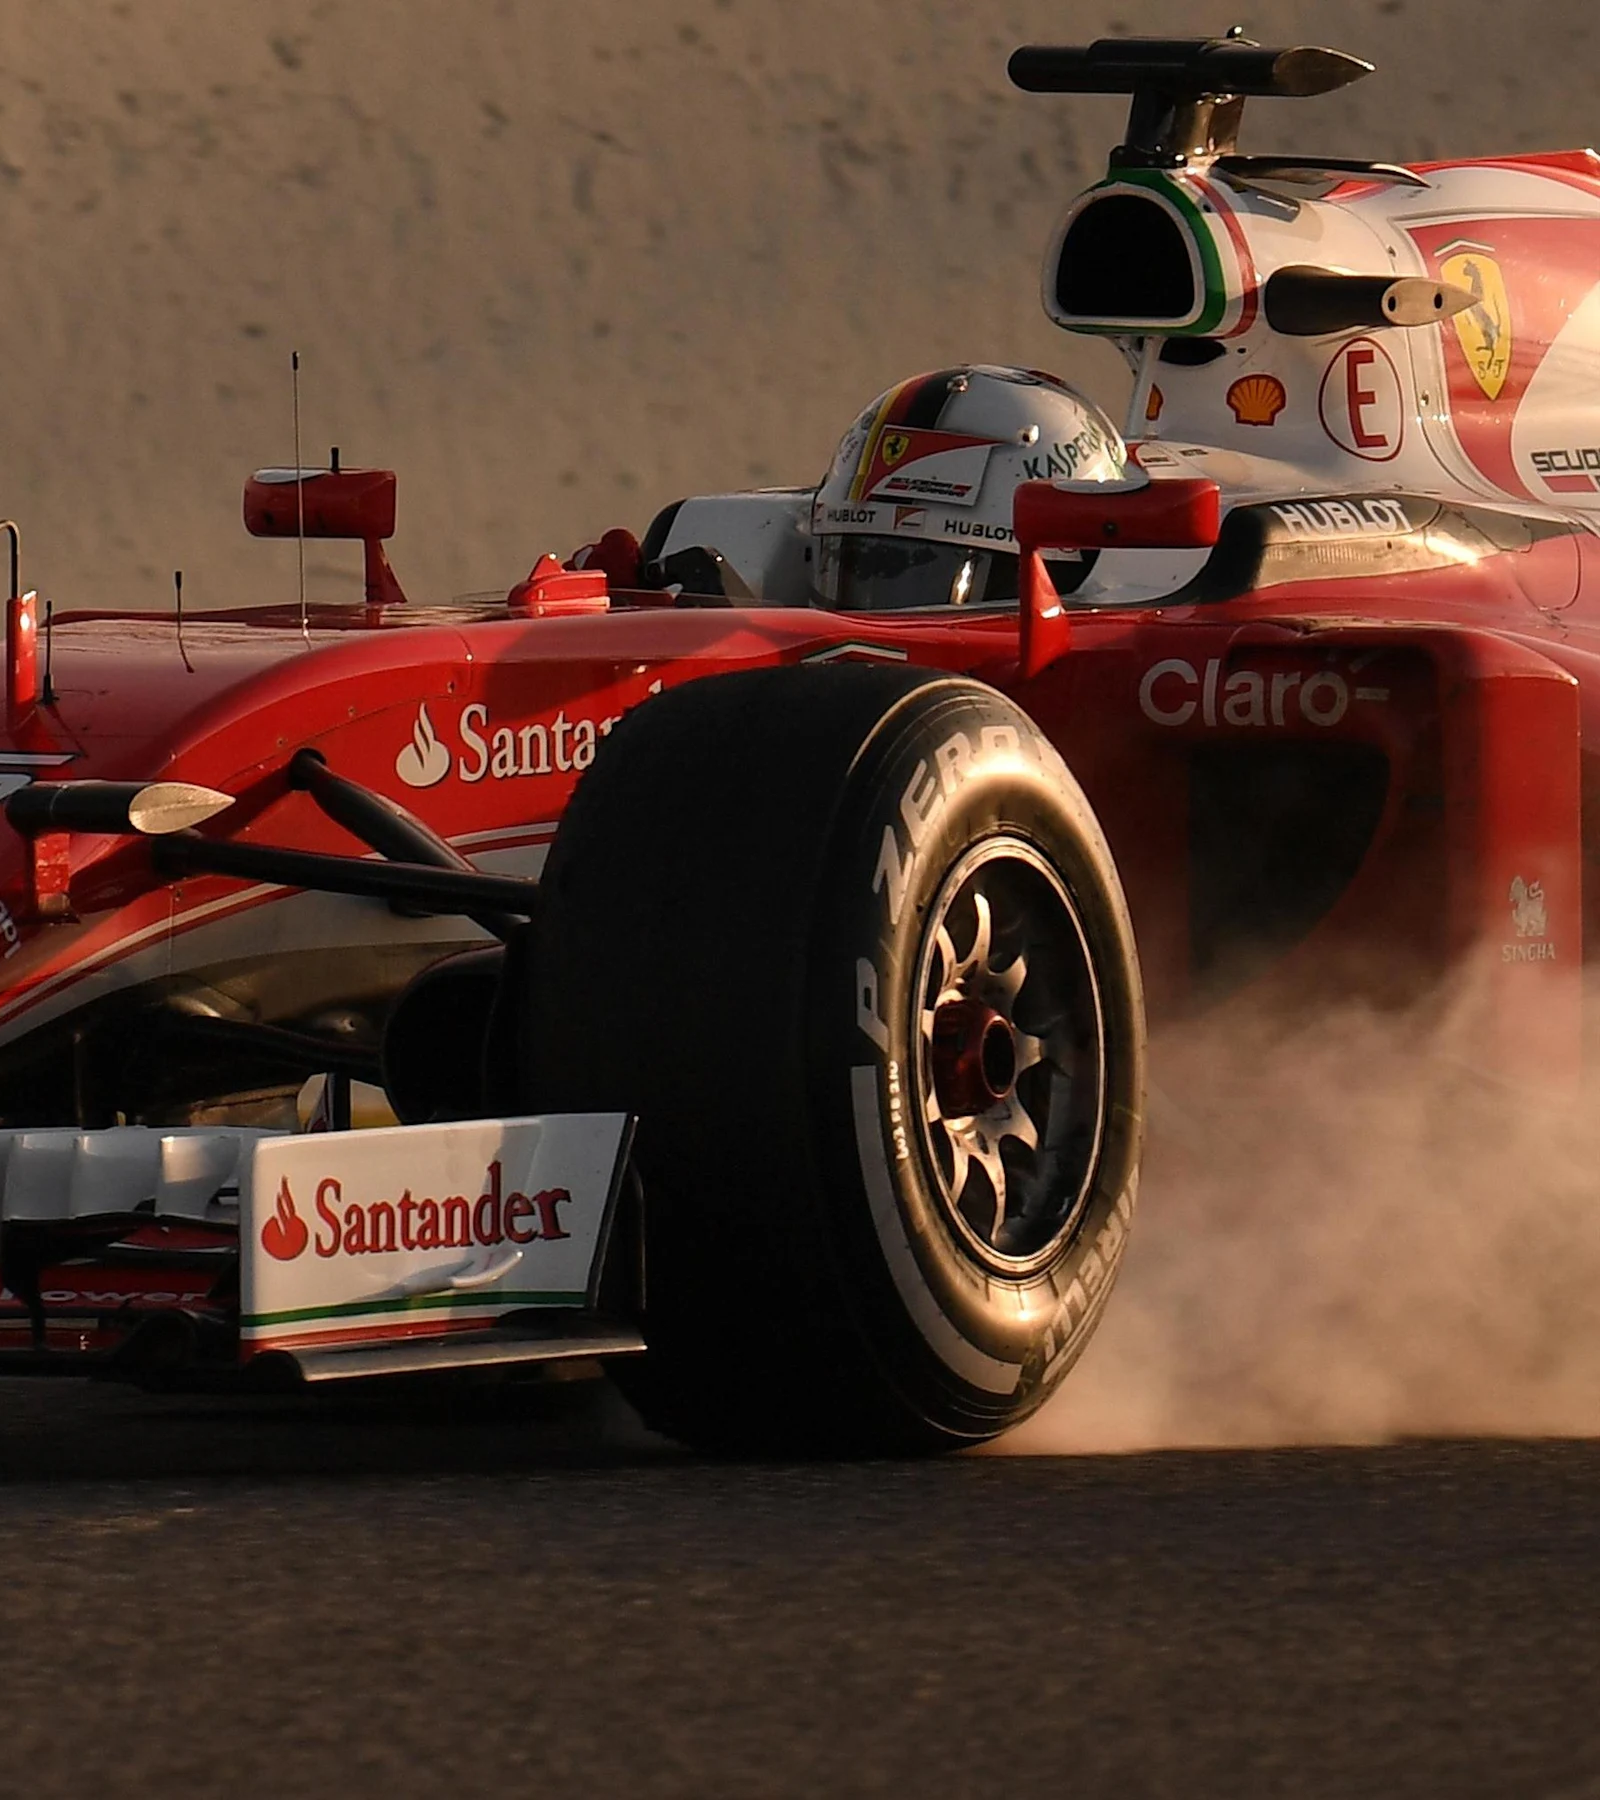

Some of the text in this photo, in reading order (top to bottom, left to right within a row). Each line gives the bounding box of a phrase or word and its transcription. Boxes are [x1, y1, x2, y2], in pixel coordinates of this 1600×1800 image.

[1345, 349, 1389, 449] E
[1530, 448, 1600, 472] SCUD
[827, 508, 877, 524] HUBLOT
[944, 519, 1014, 543] HUBLOT
[1270, 499, 1415, 536] HUBLOT
[1138, 657, 1349, 727] Claro
[458, 680, 663, 783] Santa
[1501, 943, 1556, 963] SINGHA
[856, 957, 888, 1053] P
[314, 1161, 572, 1260] Santander
